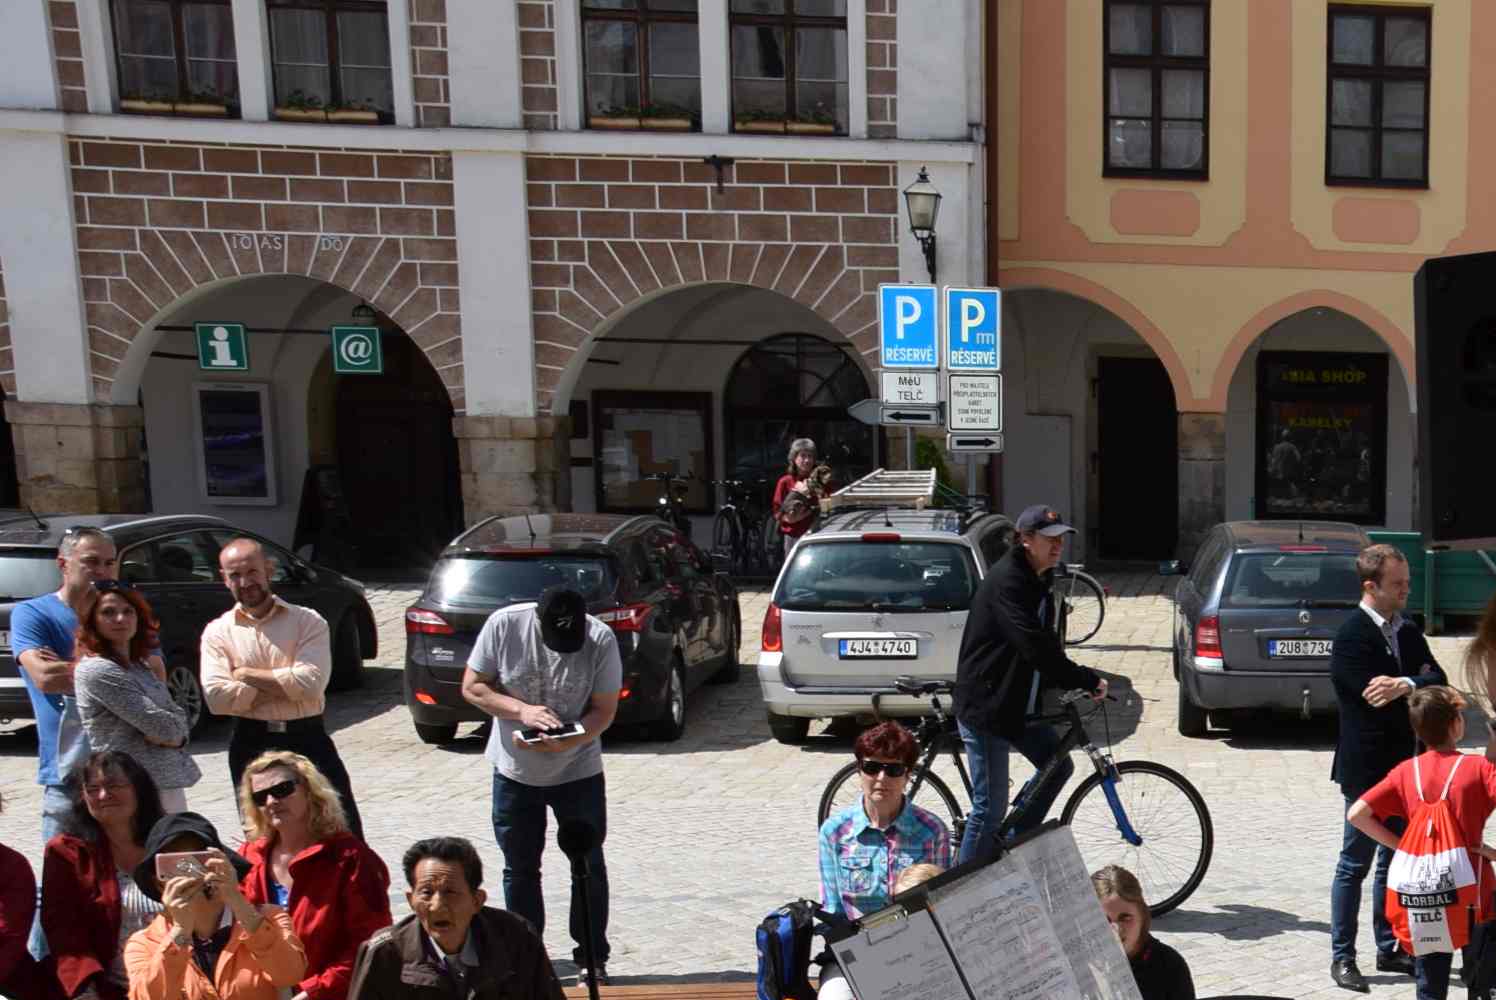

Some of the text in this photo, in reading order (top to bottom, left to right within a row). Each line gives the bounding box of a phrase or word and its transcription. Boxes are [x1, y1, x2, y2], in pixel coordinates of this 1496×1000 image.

[896, 296, 922, 340] P
[960, 298, 986, 343] P
[885, 344, 934, 362] RÉSERVÉ
[951, 347, 996, 365] RÉSERVÉ
[897, 389, 924, 401] TELČ
[849, 641, 911, 654] 4J4 4740
[1279, 642, 1302, 654] 2U8
[1402, 896, 1452, 906] FLORBAL
[1413, 910, 1442, 922] TELČ
